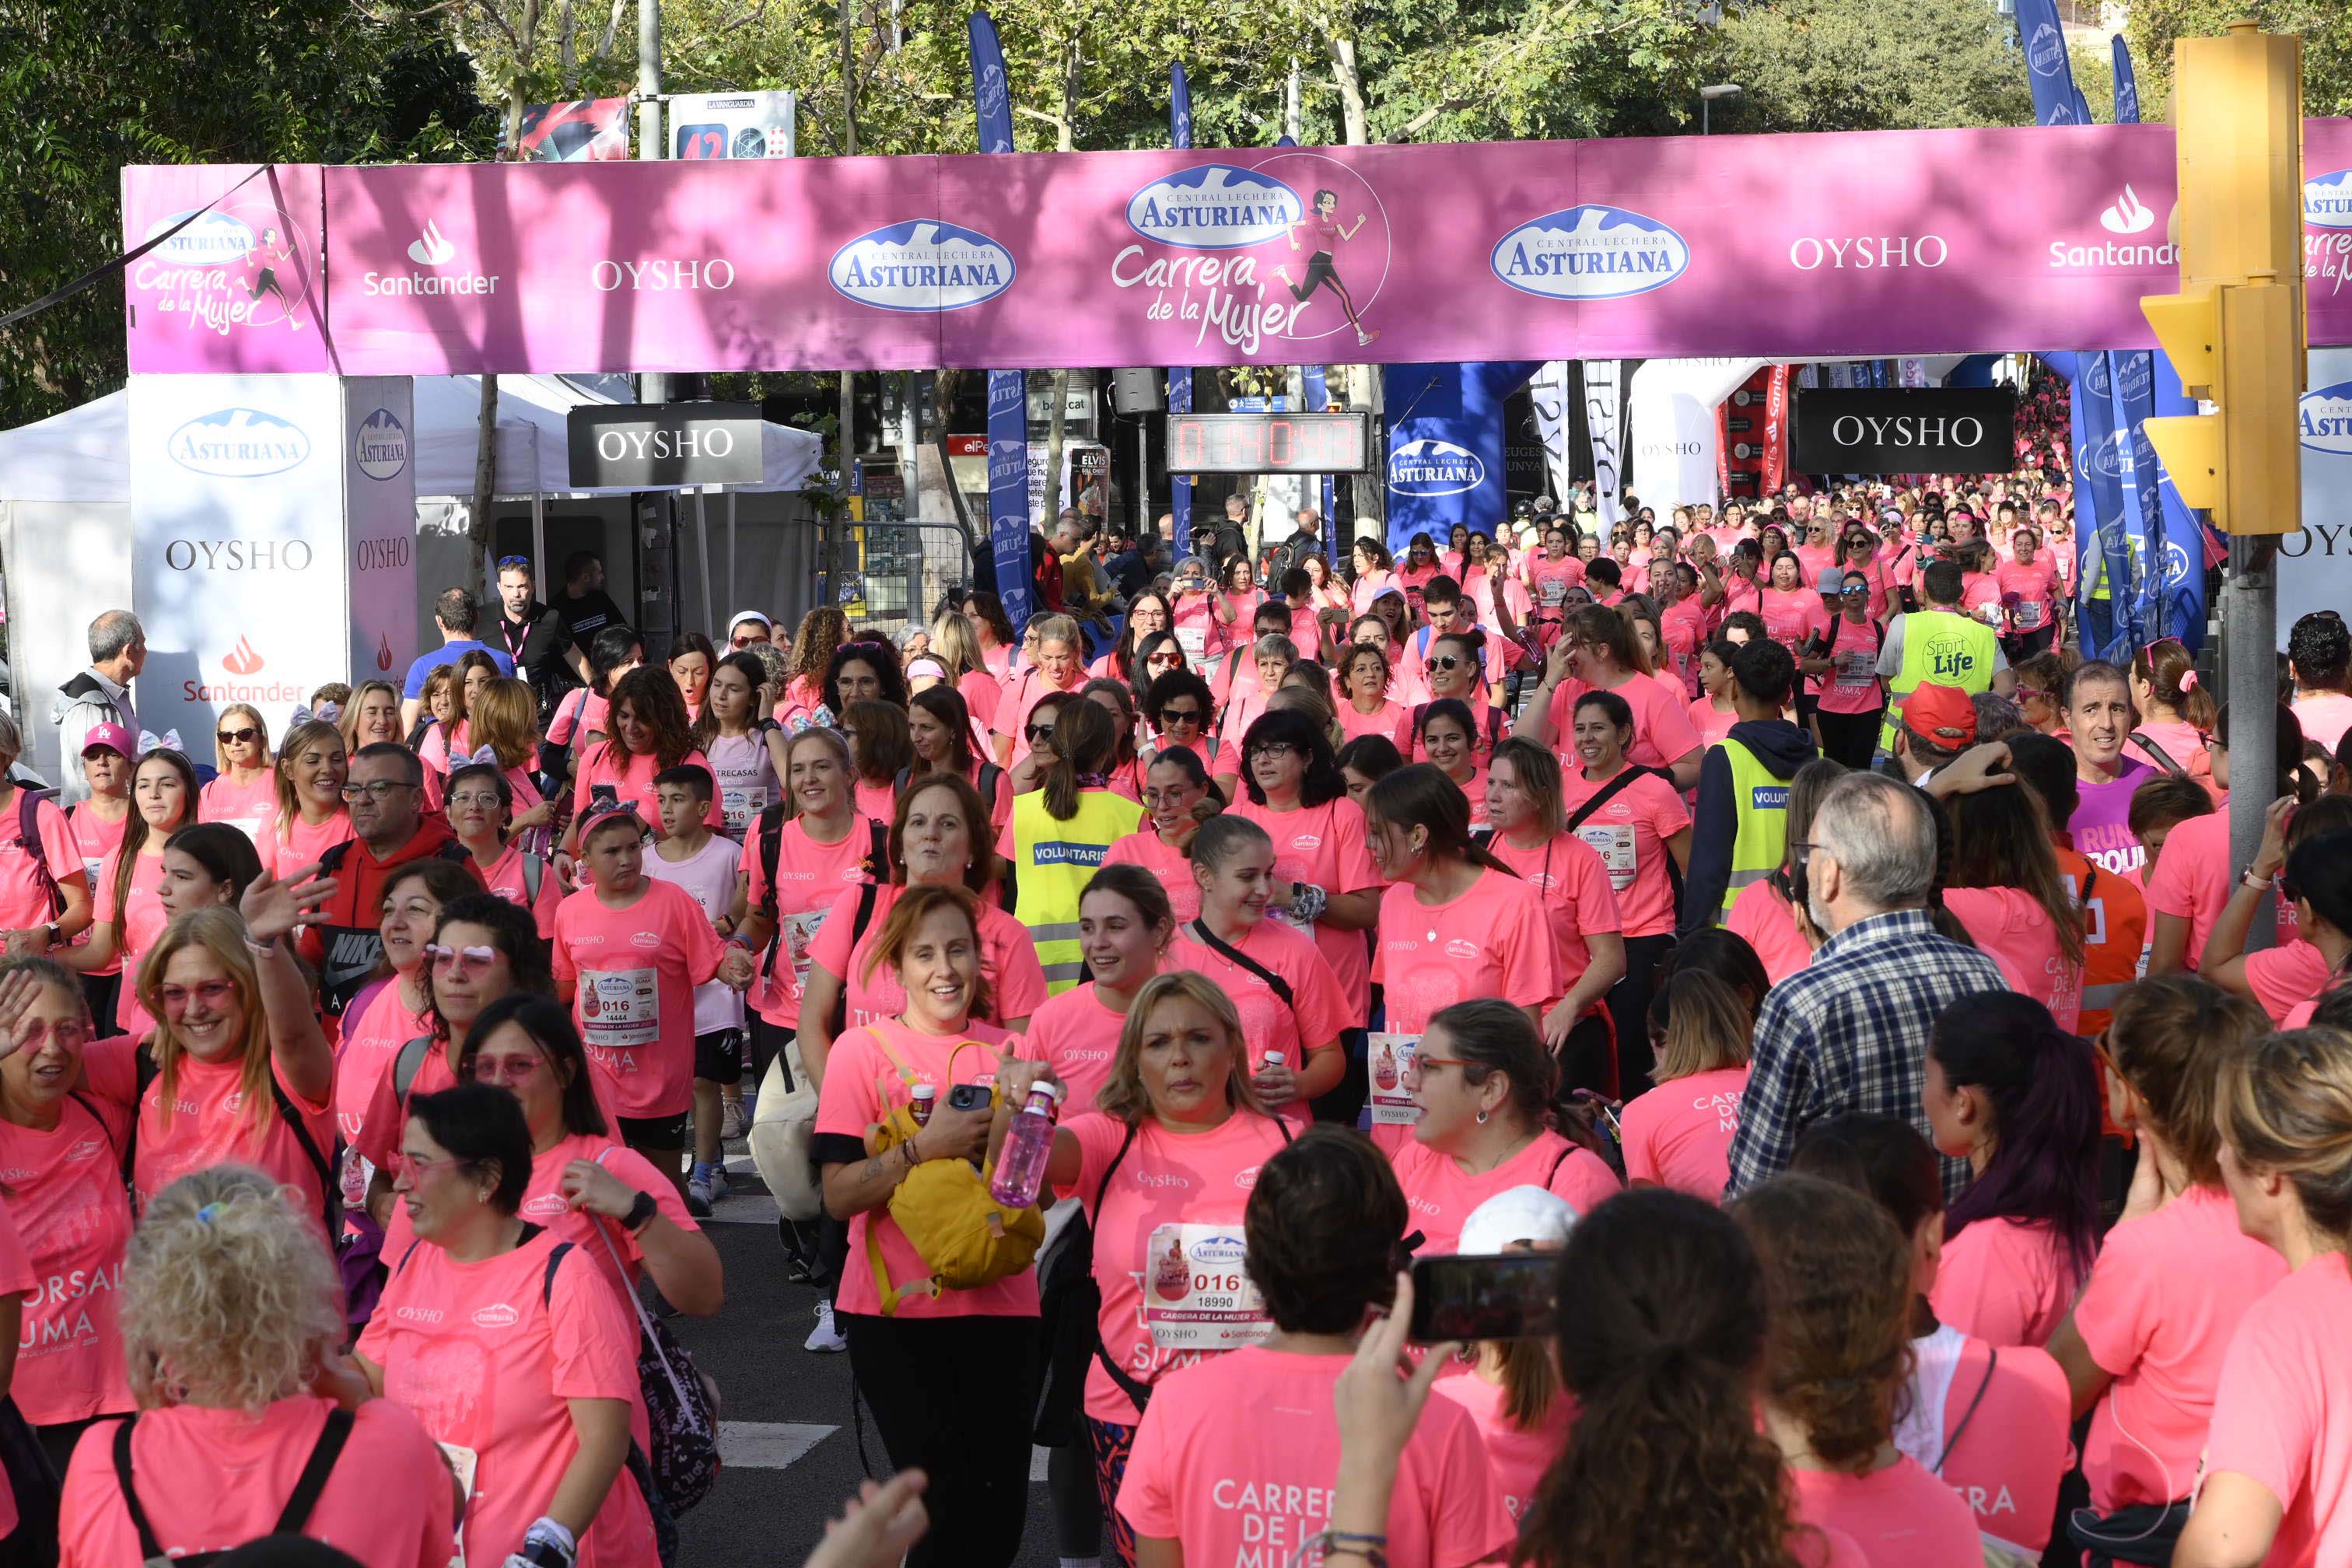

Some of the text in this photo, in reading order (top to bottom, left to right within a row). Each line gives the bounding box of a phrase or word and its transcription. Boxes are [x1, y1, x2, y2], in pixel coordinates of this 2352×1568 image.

[1167, 192, 1283, 202] CENTRAL LECHERA
[1139, 196, 1289, 228] ASTURIANA
[1537, 236, 1668, 248] CENTRAL LECHERA
[872, 250, 995, 261] CENTRAL LECHERA
[1506, 240, 1674, 276] ASTURIANA
[1790, 235, 1948, 271] OYSHO
[135, 261, 228, 290] Carrera
[591, 259, 734, 292] OYSHO
[843, 254, 1002, 289] ASTURIANA
[1111, 245, 1258, 288] Carrera
[2322, 255, 2336, 278] la
[364, 271, 499, 296] Santander
[158, 287, 262, 336] de la Mujer
[1147, 283, 1311, 355] de la Mujer
[1832, 415, 1983, 448] OYSHO
[180, 434, 299, 460] ASTURIANA
[359, 441, 405, 463] ASTURIANA
[597, 428, 733, 461] OYSHO
[1642, 443, 1702, 457] OYSHO
[1081, 452, 1106, 466] ELVIS
[1389, 463, 1478, 484] ASTURIANA
[2277, 524, 2352, 558] OY
[166, 540, 313, 571] OYSHO
[357, 537, 409, 571] OYSHO
[1927, 638, 1966, 657] Sport
[1934, 652, 1973, 677] Life
[184, 681, 306, 702] Santander
[1832, 685, 1861, 695] SUMA
[97, 725, 111, 739] LA
[1560, 752, 1573, 768] TU
[782, 872, 815, 880] OYSHO
[574, 935, 604, 945] OYSHO
[1387, 940, 1417, 950] OYSHO
[600, 982, 631, 992] ASTURIANA
[602, 1001, 630, 1011] 016
[1064, 1049, 1108, 1061] OYSHO
[1381, 1109, 1409, 1118] OYSHO
[1137, 1170, 1188, 1188] OYSHO
[1194, 1273, 1240, 1292] 016
[1198, 1297, 1233, 1307] 18990
[397, 1306, 443, 1323] OYSHO
[1156, 1328, 1198, 1339] OYSHO
[1243, 1513, 1286, 1545] DE
